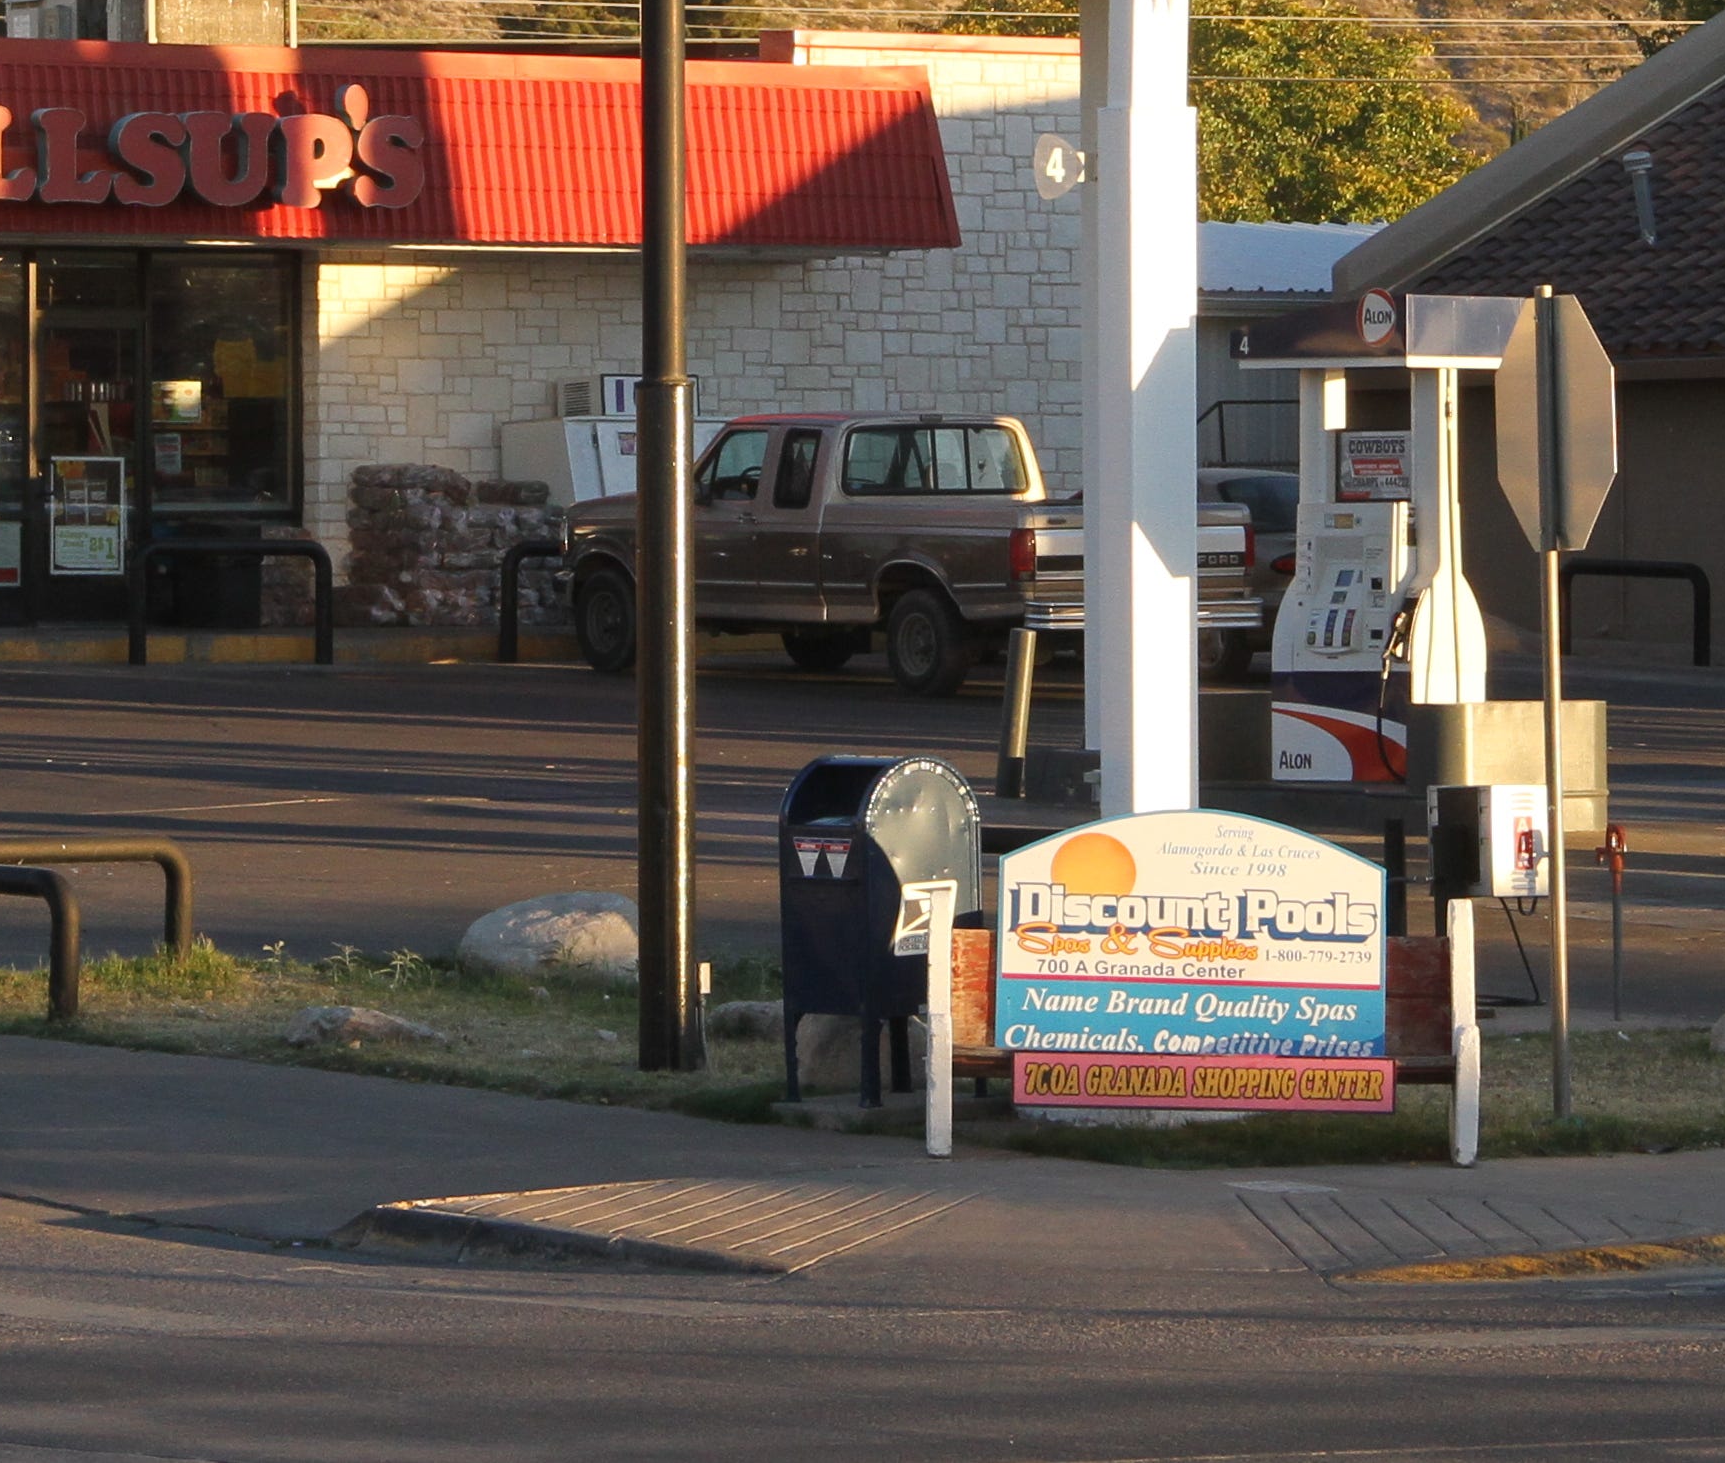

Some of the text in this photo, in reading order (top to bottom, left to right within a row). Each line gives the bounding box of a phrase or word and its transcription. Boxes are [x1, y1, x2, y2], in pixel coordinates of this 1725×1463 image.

[1045, 146, 1066, 184] 4
[1364, 307, 1393, 325] ALON
[1239, 335, 1250, 355] 4
[1348, 439, 1406, 455] COWBOYS
[1197, 553, 1240, 566] FORD
[1279, 749, 1313, 770] ALON
[1216, 824, 1255, 841] Serving
[1158, 841, 1322, 860] Alamogordo & Las Cruces
[1190, 861, 1288, 878] Since 1998
[1012, 881, 1379, 941] Discount Pools
[1015, 921, 1259, 962] Spas & Supplies
[1265, 949, 1373, 964] 1-800-779-2739
[1037, 958, 1246, 979] 700 A Granada Center
[1021, 987, 1358, 1026] Name Brand Quality Spas
[1153, 1029, 1294, 1056] Competitive
[1298, 1034, 1375, 1057] Prices
[1085, 1064, 1187, 1098] GRANADA
[1191, 1066, 1297, 1100] SHOPPING
[1298, 1069, 1384, 1102] CENTER
